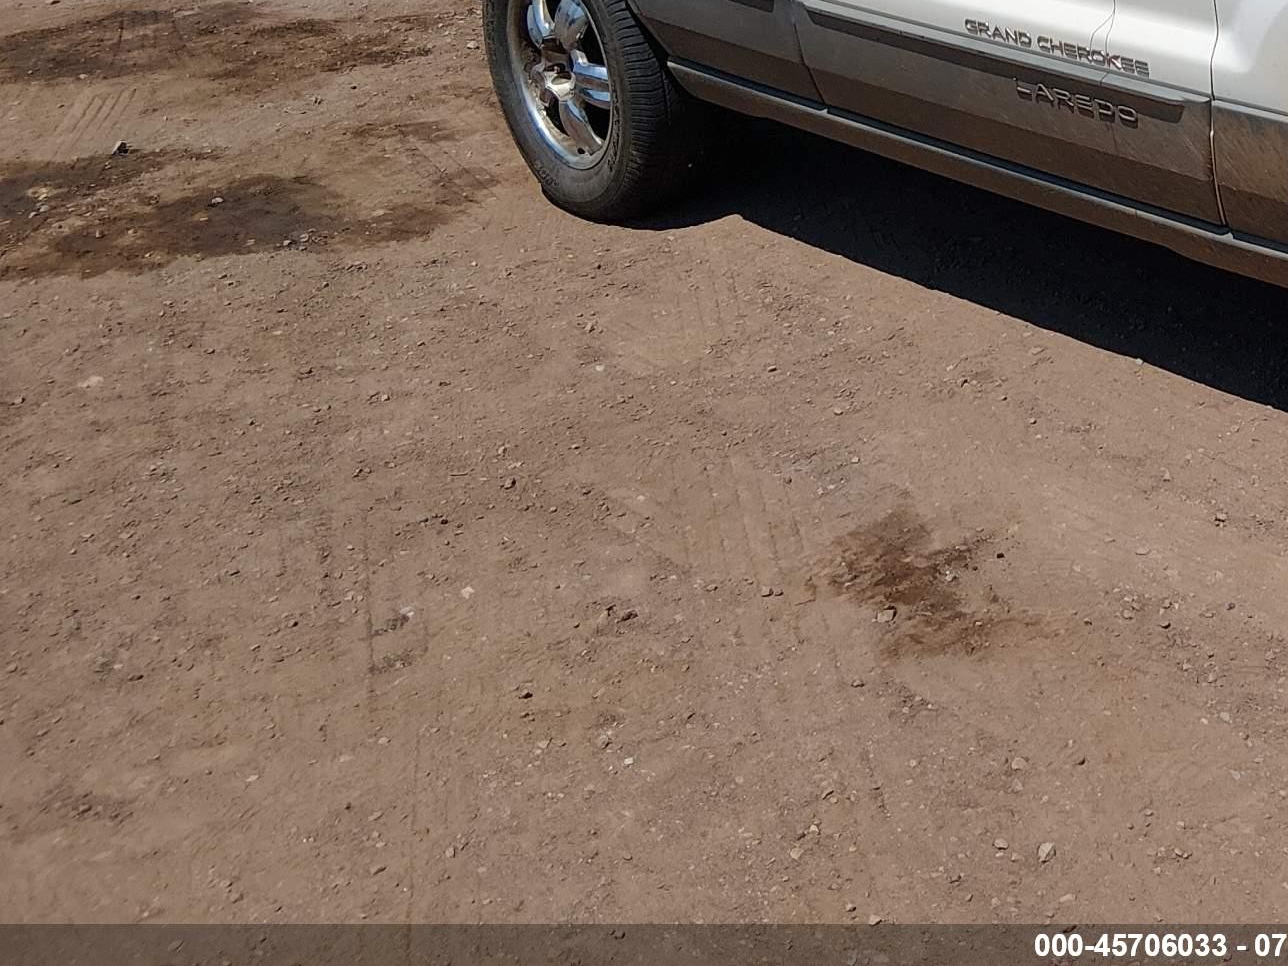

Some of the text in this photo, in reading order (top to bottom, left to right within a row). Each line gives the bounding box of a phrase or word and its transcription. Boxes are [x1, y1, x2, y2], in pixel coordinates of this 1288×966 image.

[965, 18, 1150, 78] GRAND CHEROKEE
[1013, 77, 1139, 128] LAREDO
